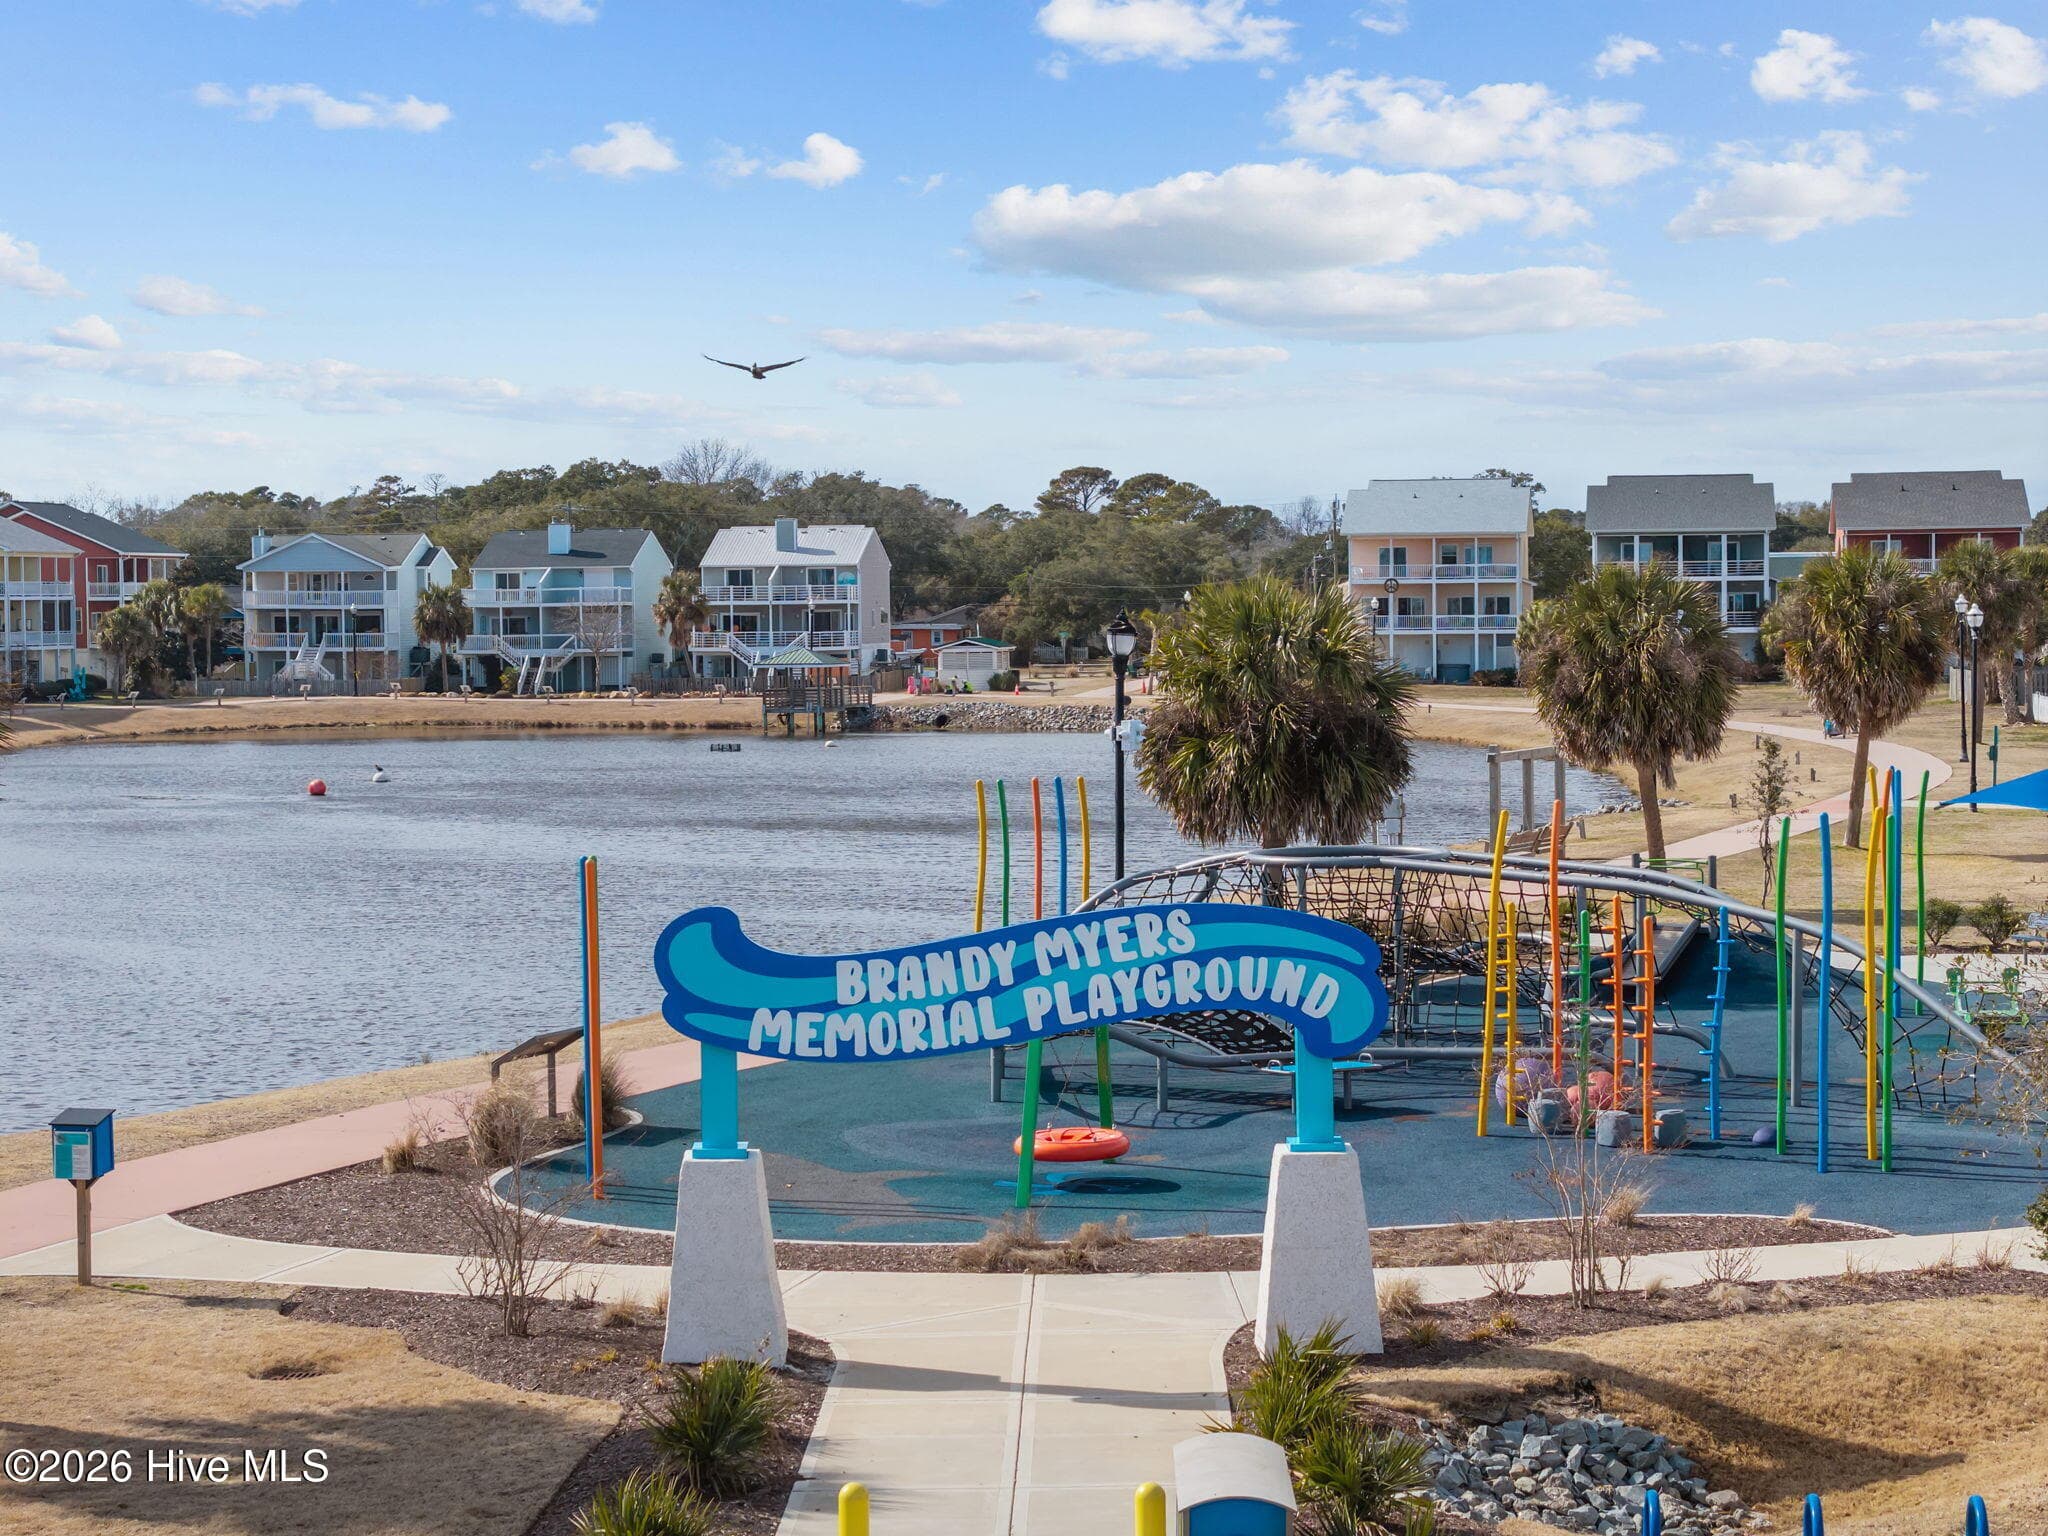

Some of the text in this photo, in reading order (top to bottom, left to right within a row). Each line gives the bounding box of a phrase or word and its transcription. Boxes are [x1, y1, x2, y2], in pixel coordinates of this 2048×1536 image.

[837, 910, 1196, 1004] BRANDY MYERS
[748, 957, 1340, 1058] MEMORIAL PLAYGROUND
